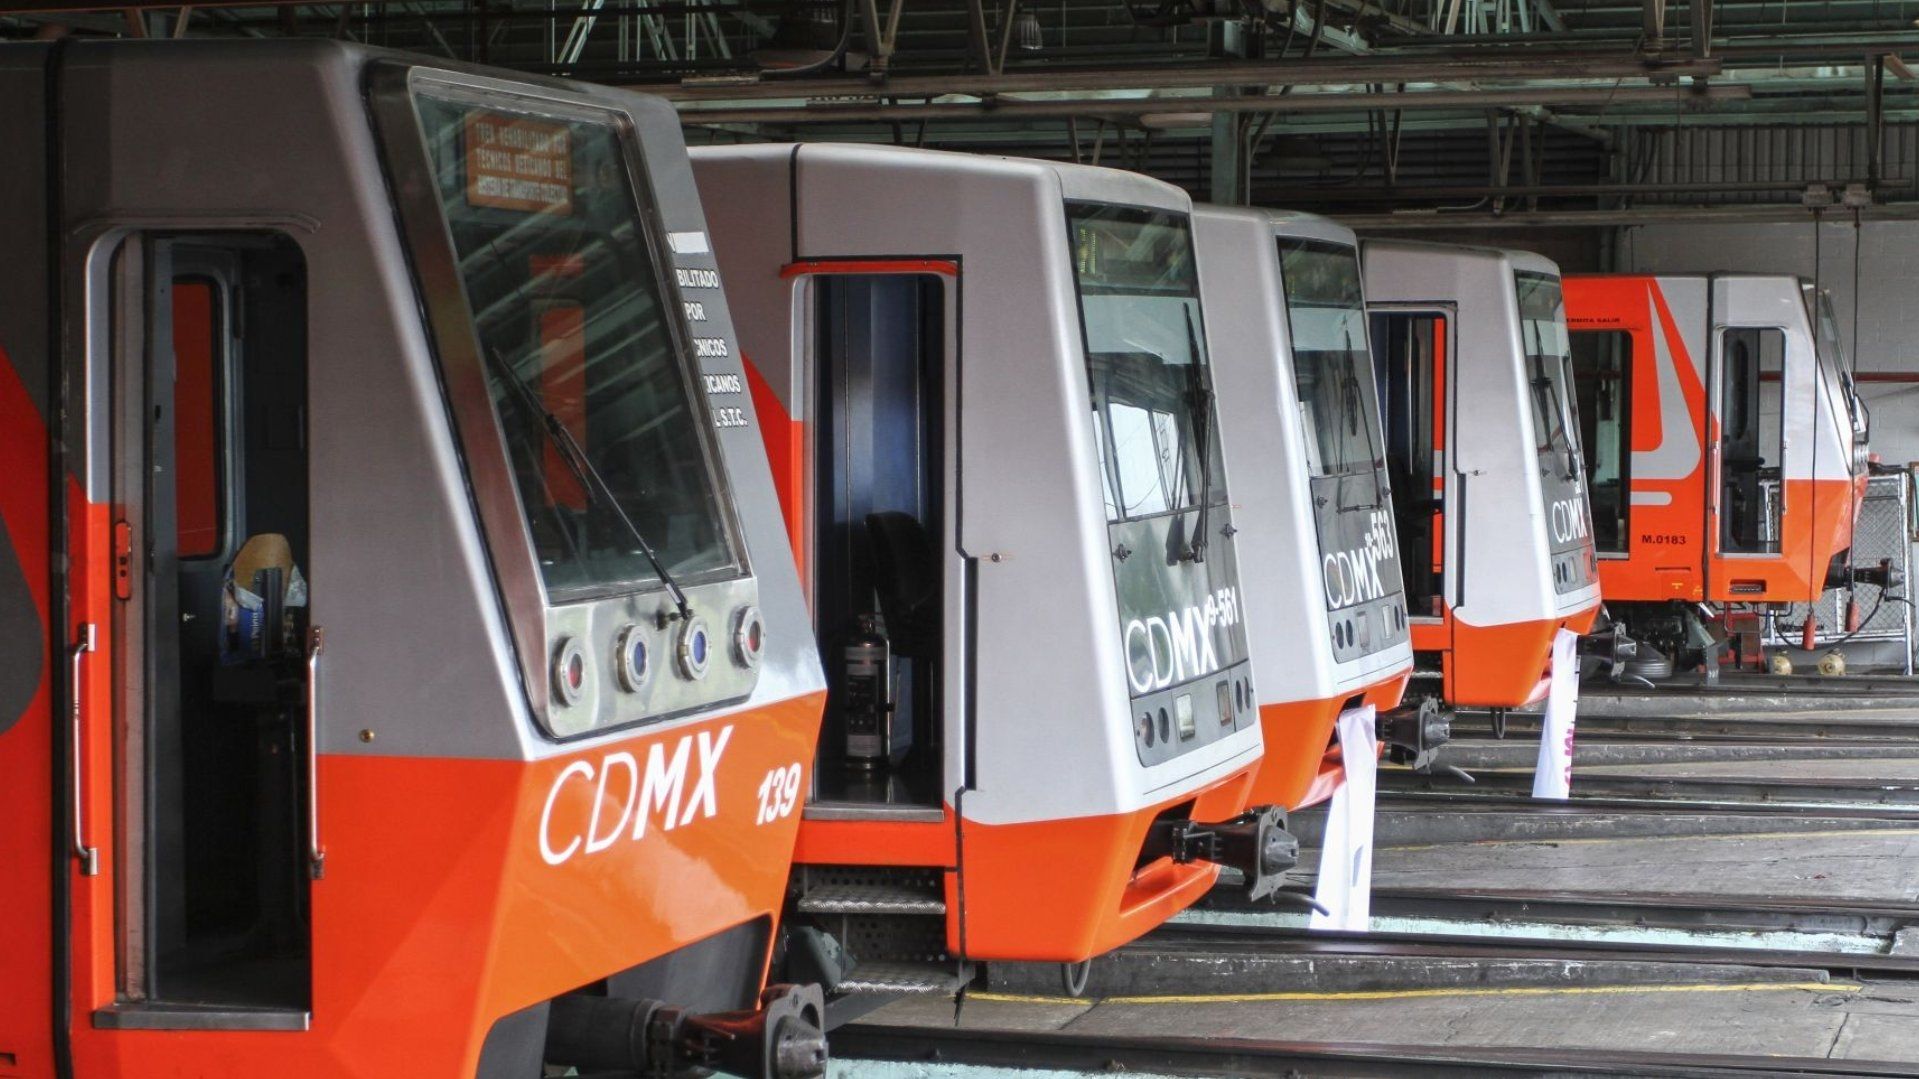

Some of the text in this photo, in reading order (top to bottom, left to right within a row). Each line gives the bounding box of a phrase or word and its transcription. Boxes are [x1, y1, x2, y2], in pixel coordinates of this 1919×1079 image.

[676, 268, 720, 288] BILITADO
[684, 302, 706, 320] POR
[720, 408, 749, 427] S.T.C.
[1553, 497, 1588, 543] CDMX
[1641, 533, 1687, 545] M.0183
[1324, 547, 1385, 609] CDMX
[1125, 586, 1239, 693] CDMX 9-561
[539, 724, 802, 866] CDMX 139
